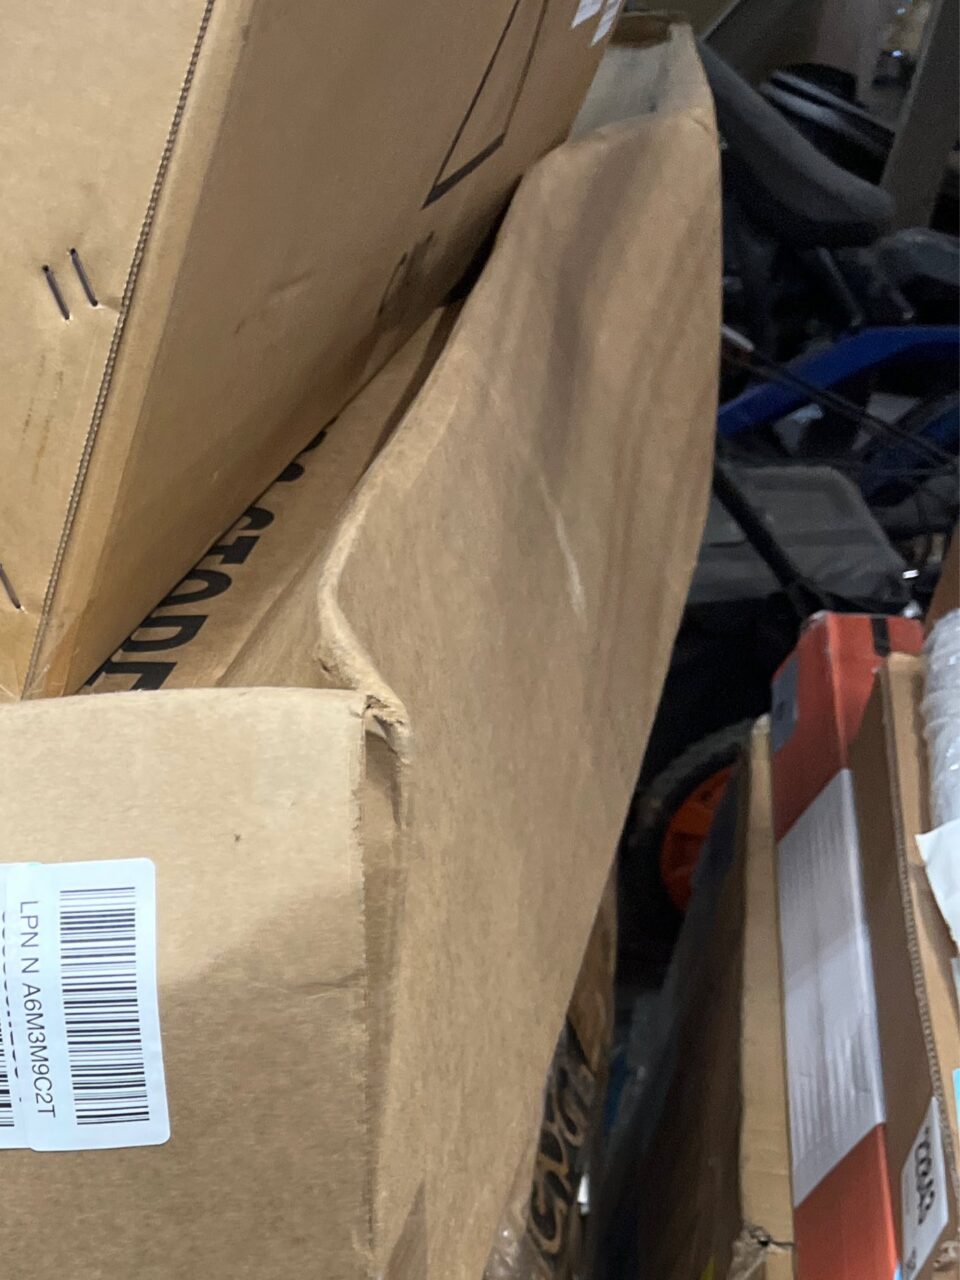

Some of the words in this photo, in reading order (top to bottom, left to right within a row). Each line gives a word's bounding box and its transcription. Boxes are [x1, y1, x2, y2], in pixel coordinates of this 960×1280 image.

[20, 900, 40, 949] LPN
[21, 956, 40, 975] N
[21, 981, 57, 1119] A6M3M9C2T
